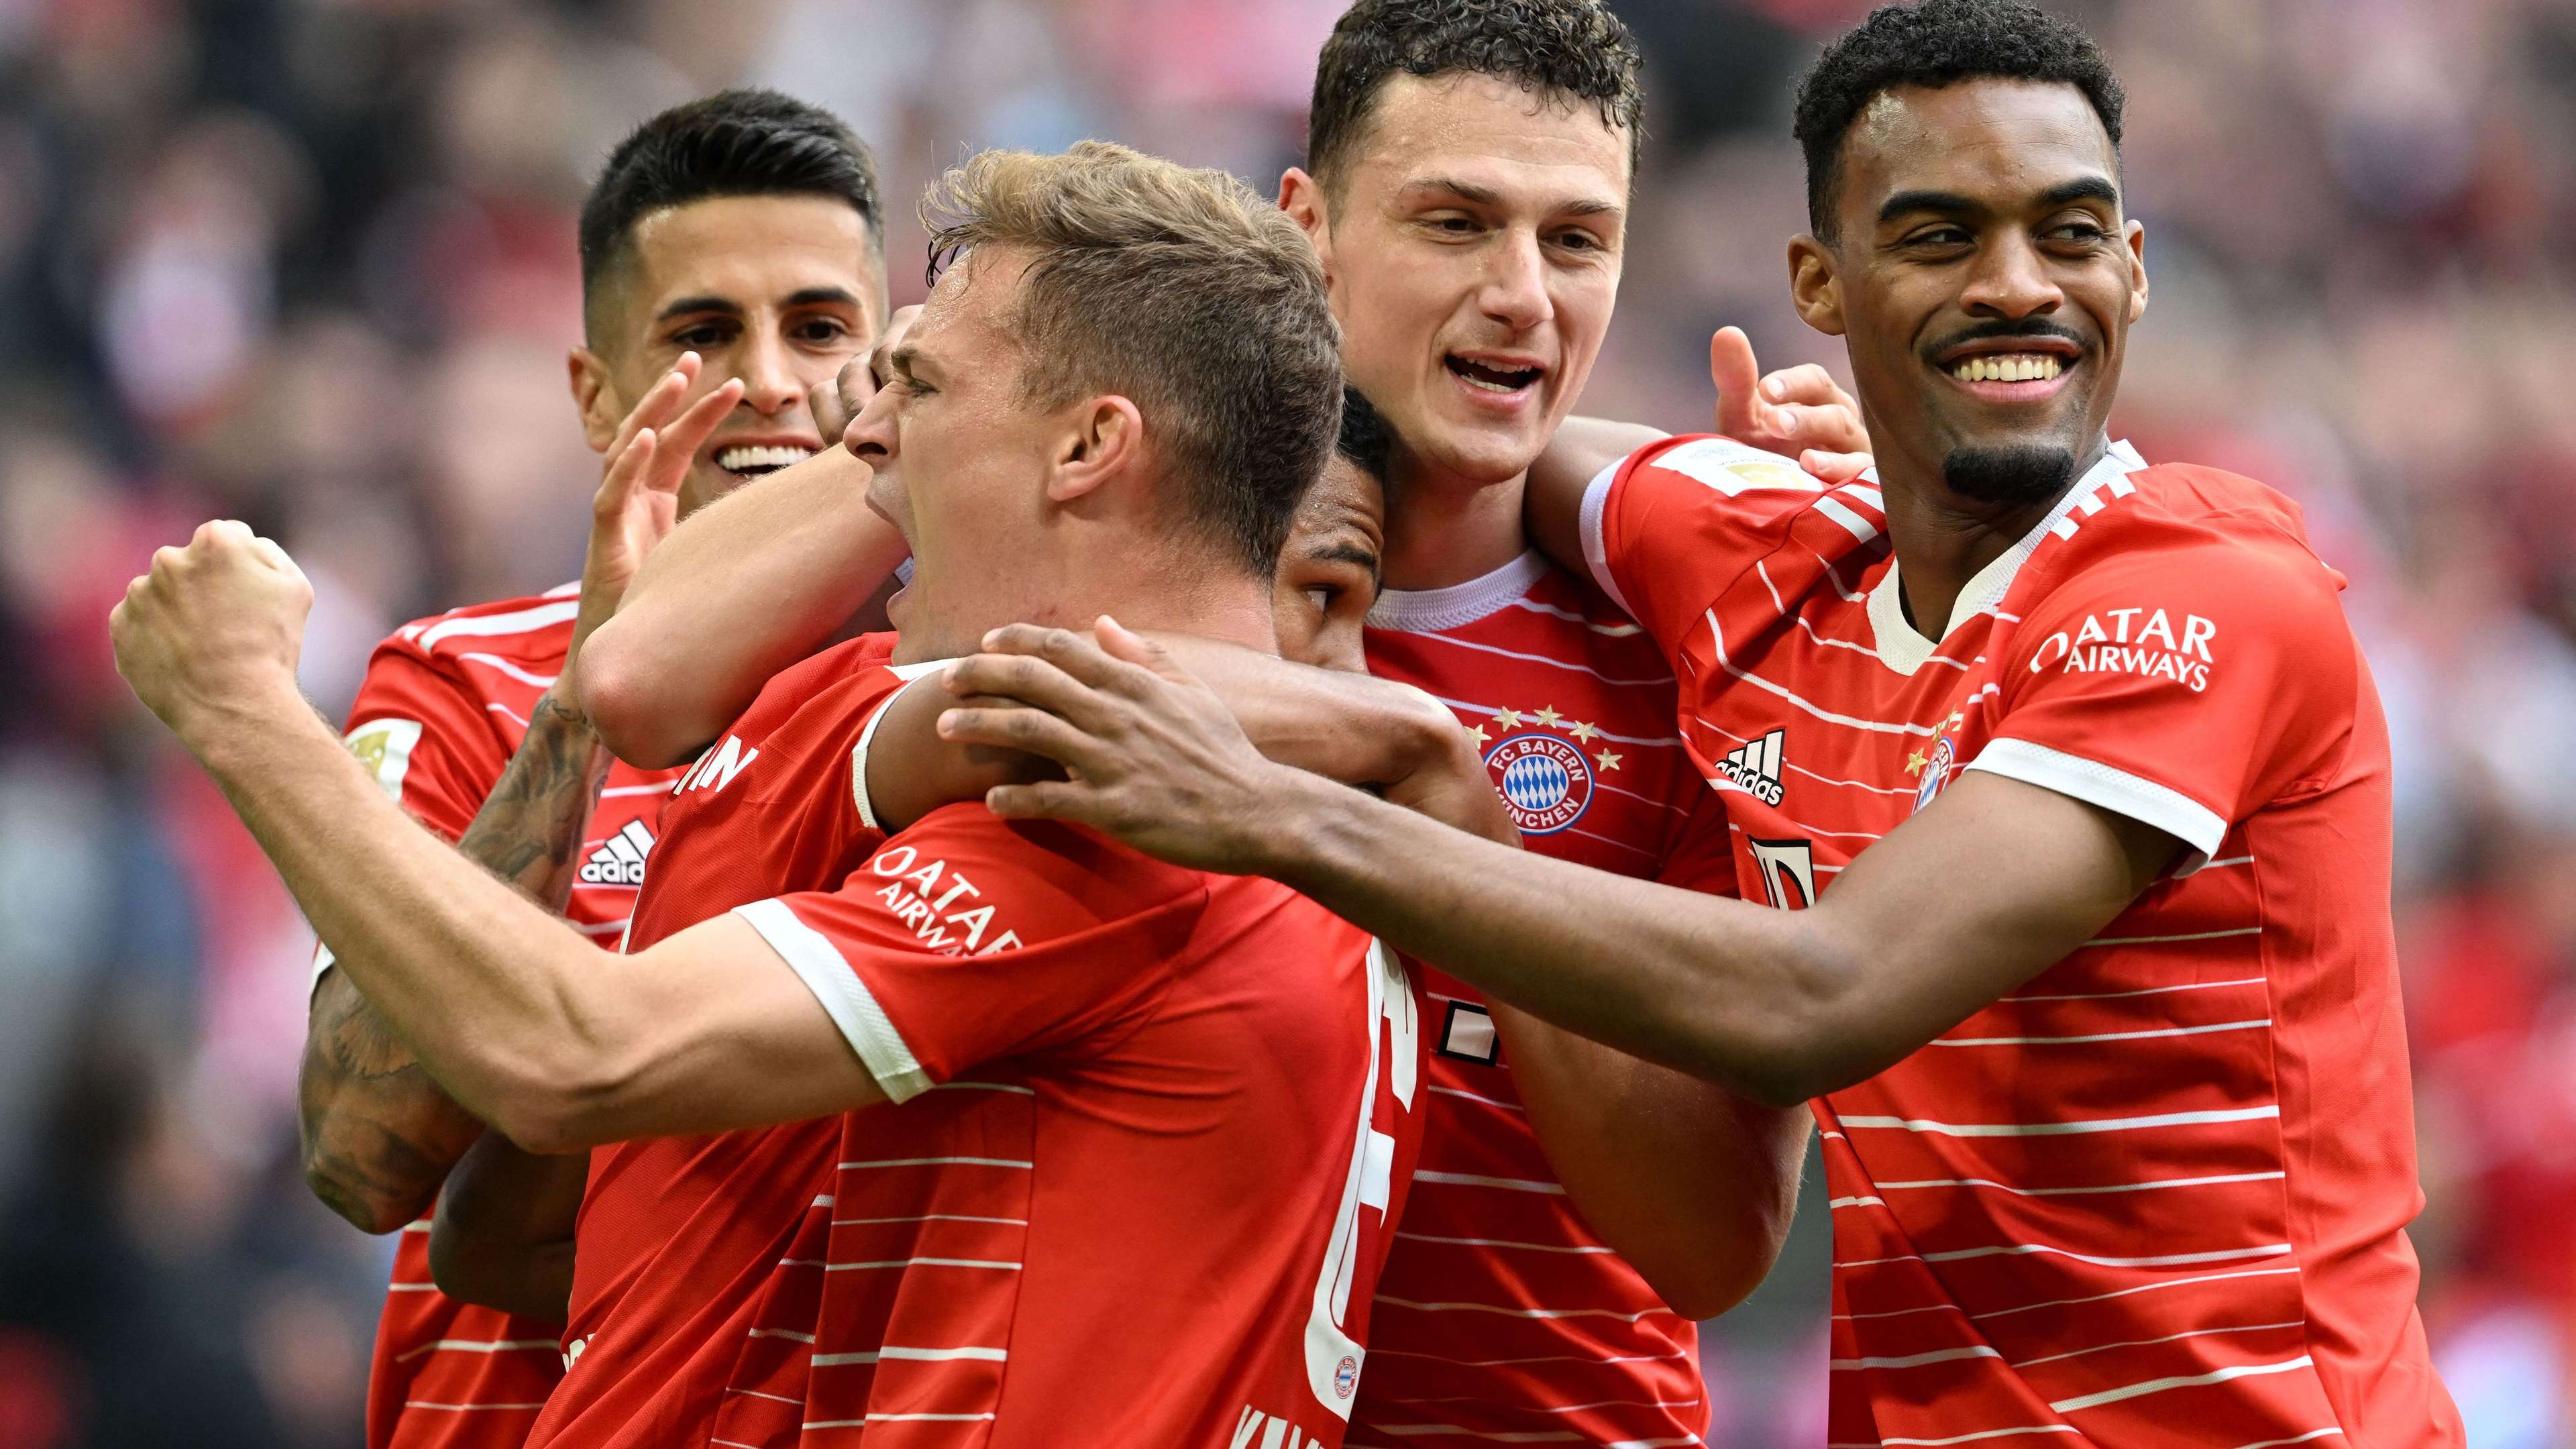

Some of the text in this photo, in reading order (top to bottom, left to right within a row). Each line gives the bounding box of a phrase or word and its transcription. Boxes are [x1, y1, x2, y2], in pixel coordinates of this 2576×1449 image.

[2063, 646, 2210, 692] AIRWAYS
[1491, 740, 1585, 782] FC BAYERN
